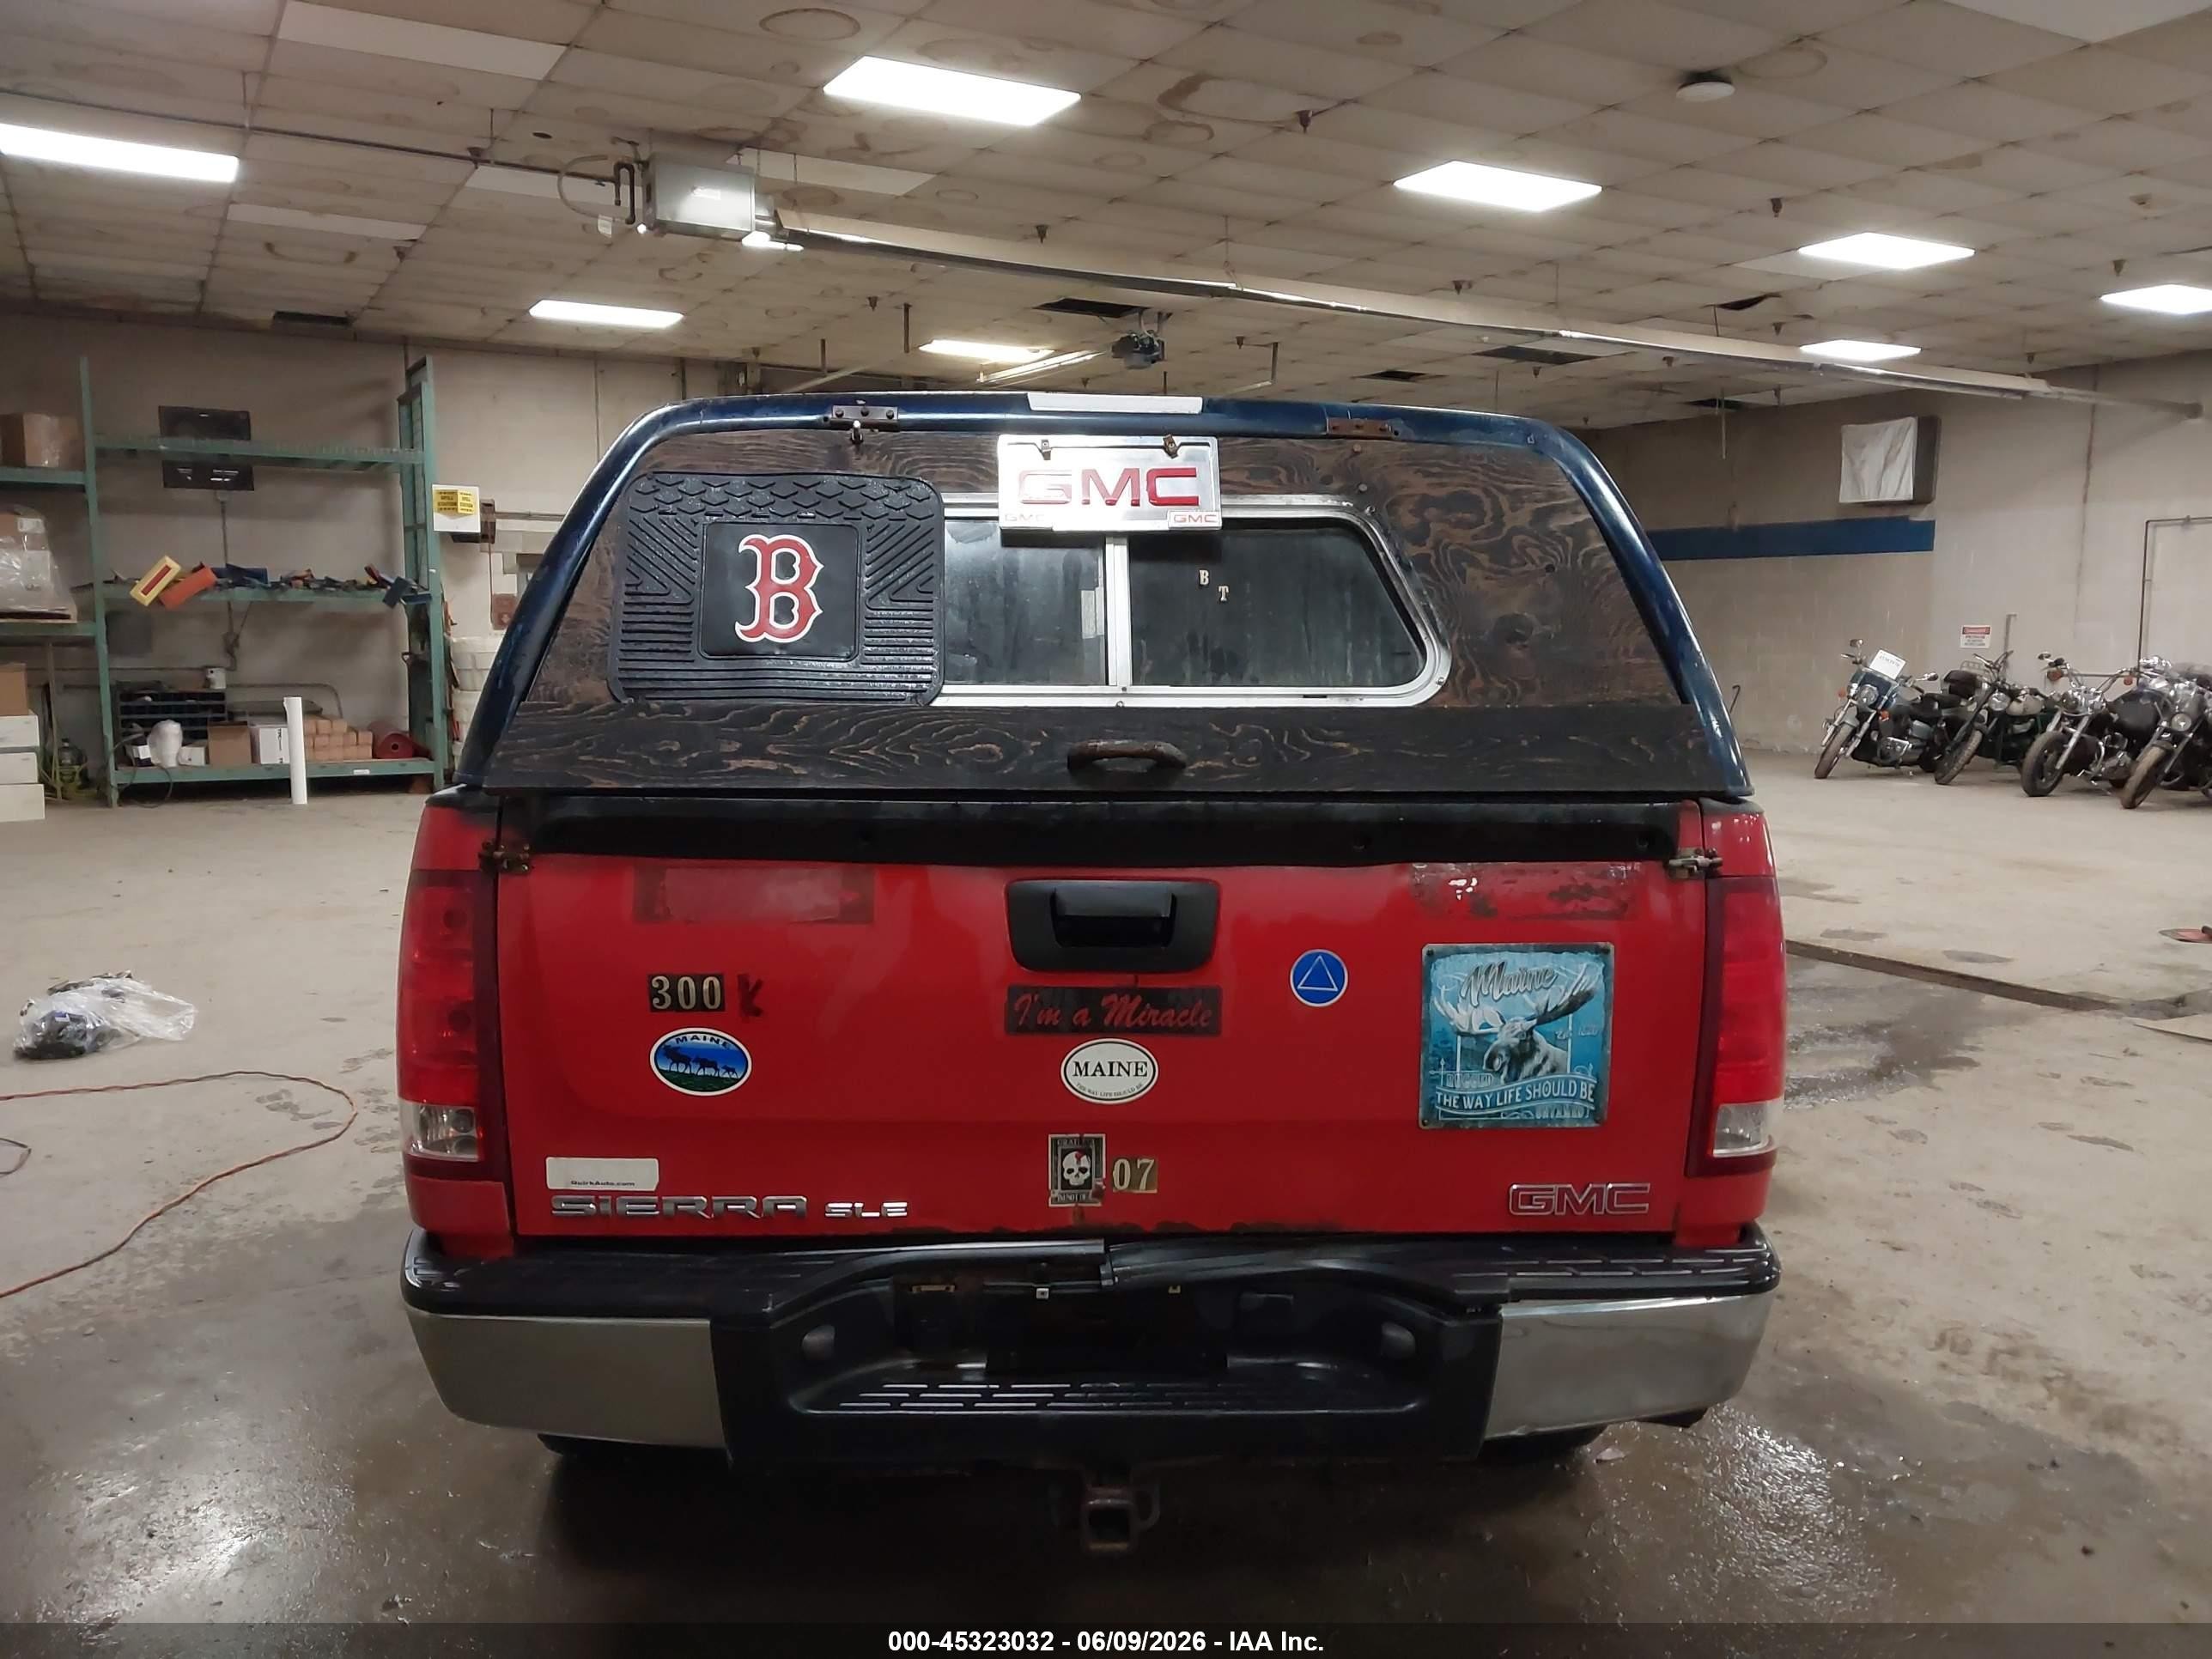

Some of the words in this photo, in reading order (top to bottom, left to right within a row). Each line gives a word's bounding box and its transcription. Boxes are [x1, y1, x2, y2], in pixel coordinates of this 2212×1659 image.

[1018, 468, 1200, 507] GMC
[1173, 514, 1218, 523] GMC
[735, 534, 824, 643] B
[1199, 569, 1210, 585] B
[1218, 585, 1230, 602] T
[651, 975, 722, 1010] 300
[1461, 961, 1558, 1007] Maine
[1014, 993, 1061, 1026] I'm
[1073, 1006, 1091, 1025] a
[1101, 993, 1212, 1028] Miracle
[675, 1035, 732, 1048] MAINE
[1073, 1060, 1148, 1077] MAINE
[1436, 1091, 1459, 1109] THE
[1462, 1094, 1493, 1109] WAY
[1496, 1086, 1522, 1106] LIFE
[1525, 1079, 1577, 1101] SHOULD
[1579, 1080, 1595, 1103] BE
[1113, 1158, 1155, 1190] 07
[551, 1195, 808, 1218] SIERRA
[825, 1202, 908, 1218] SLE
[1509, 1182, 1650, 1216] GMC
